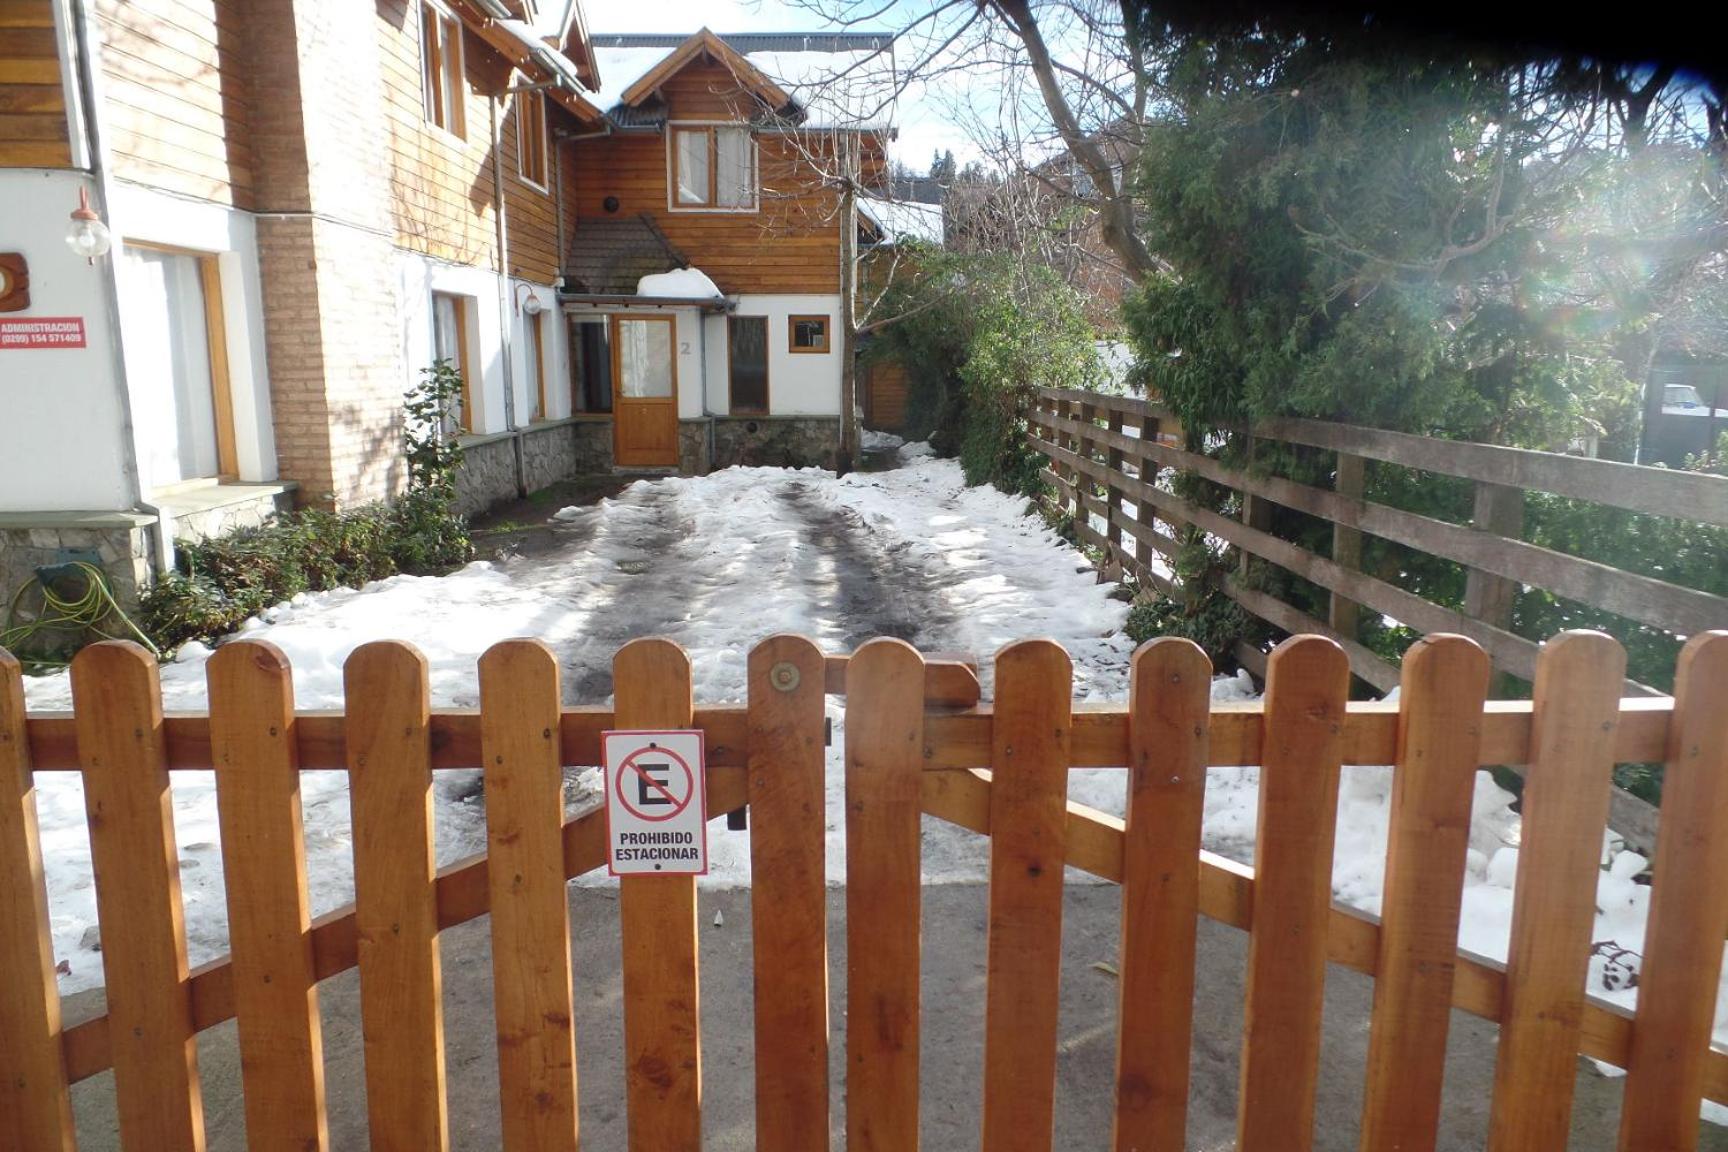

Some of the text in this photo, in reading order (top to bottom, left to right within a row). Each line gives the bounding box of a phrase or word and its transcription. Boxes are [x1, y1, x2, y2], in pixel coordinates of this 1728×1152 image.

[31, 333, 47, 343] 154
[680, 341, 692, 355] 2
[637, 763, 671, 805] E
[620, 832, 693, 845] PROHIBIDO
[615, 847, 699, 861] ESTACIONAR
